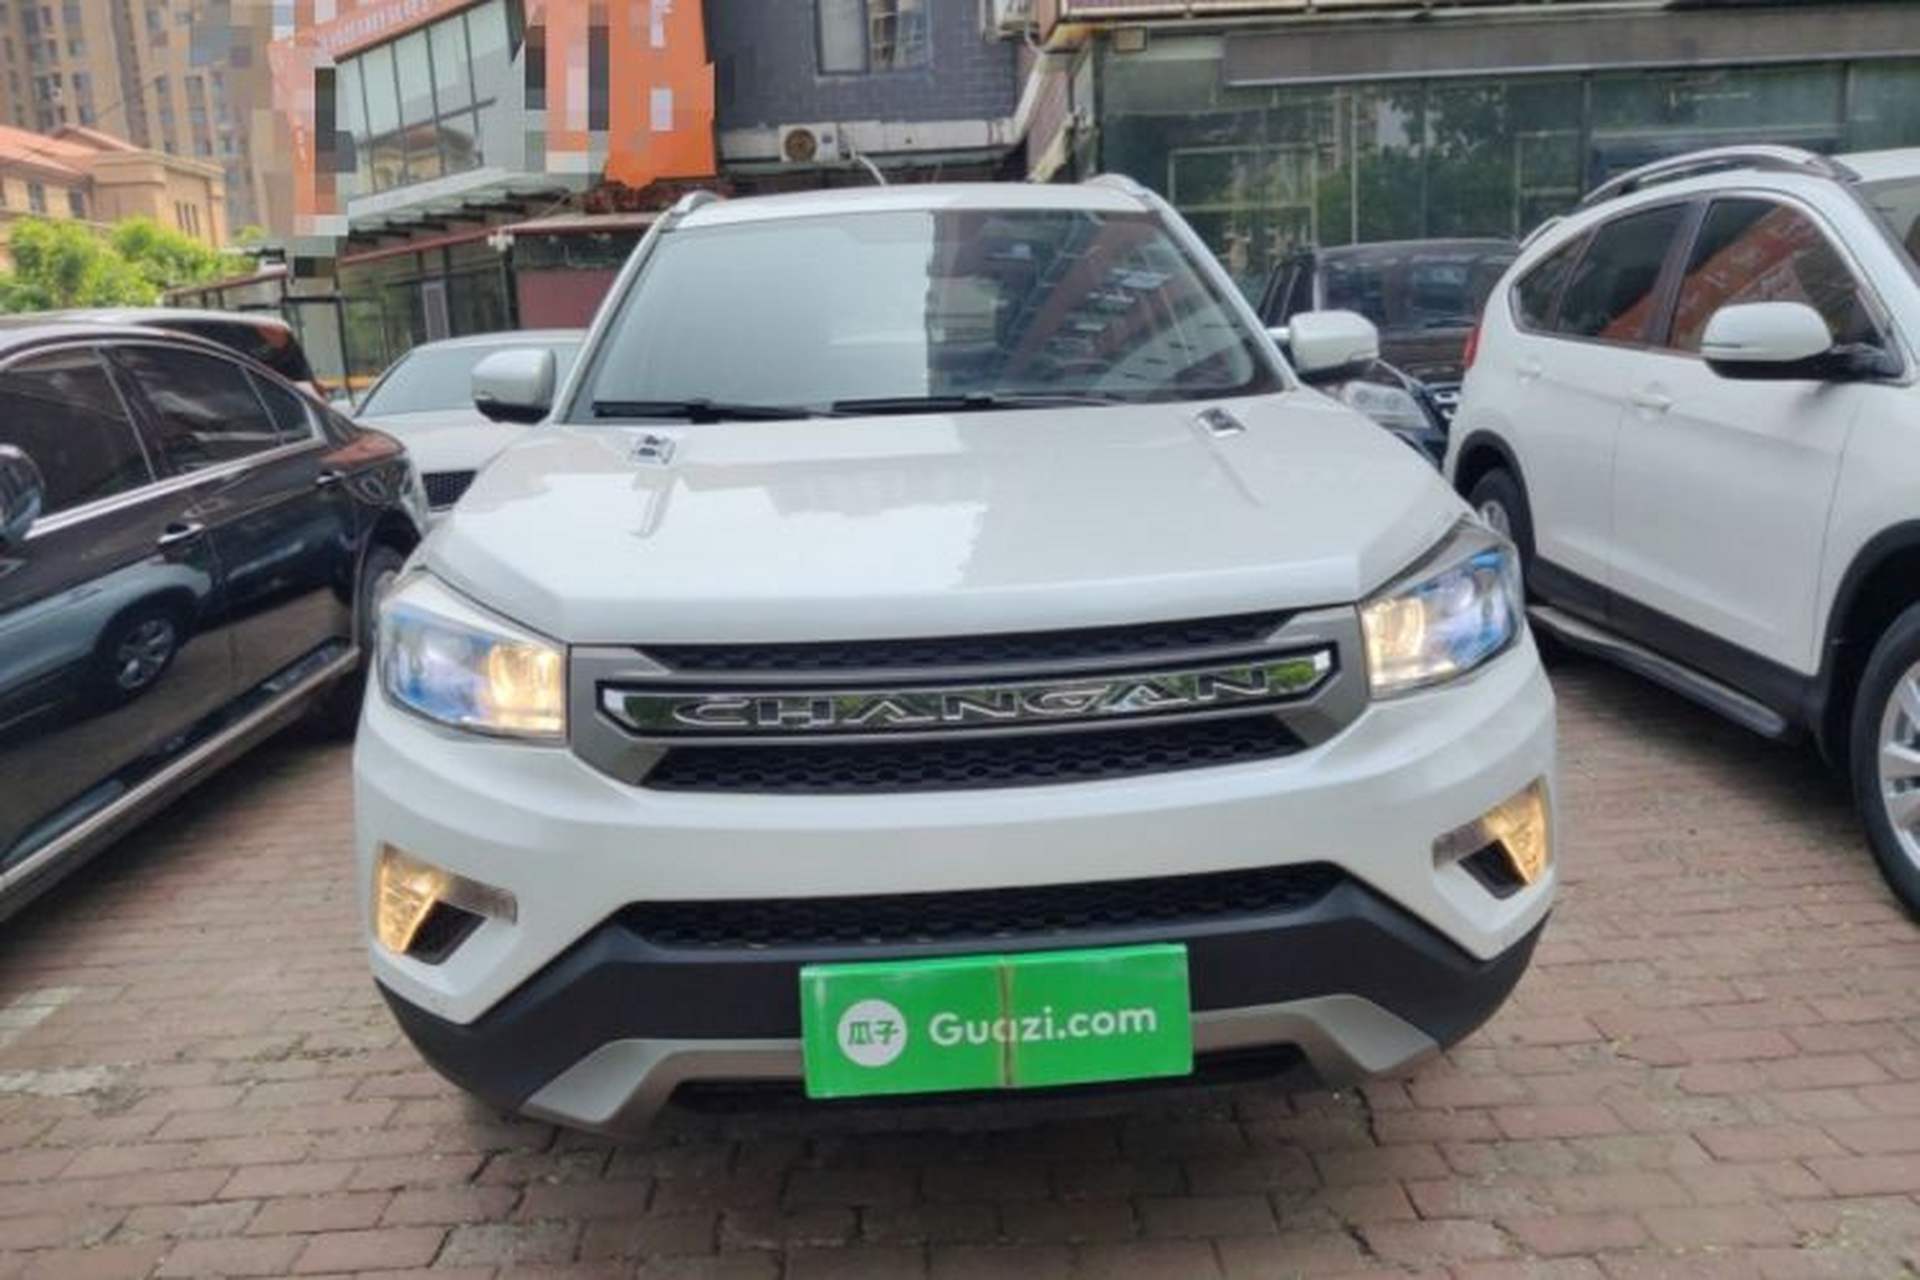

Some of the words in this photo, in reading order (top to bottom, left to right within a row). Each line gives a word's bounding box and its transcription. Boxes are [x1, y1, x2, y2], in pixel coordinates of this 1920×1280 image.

[672, 666, 1269, 727] CHANGAN
[847, 1019, 900, 1047] 瓜子
[929, 1006, 1158, 1047] Guazi.com
